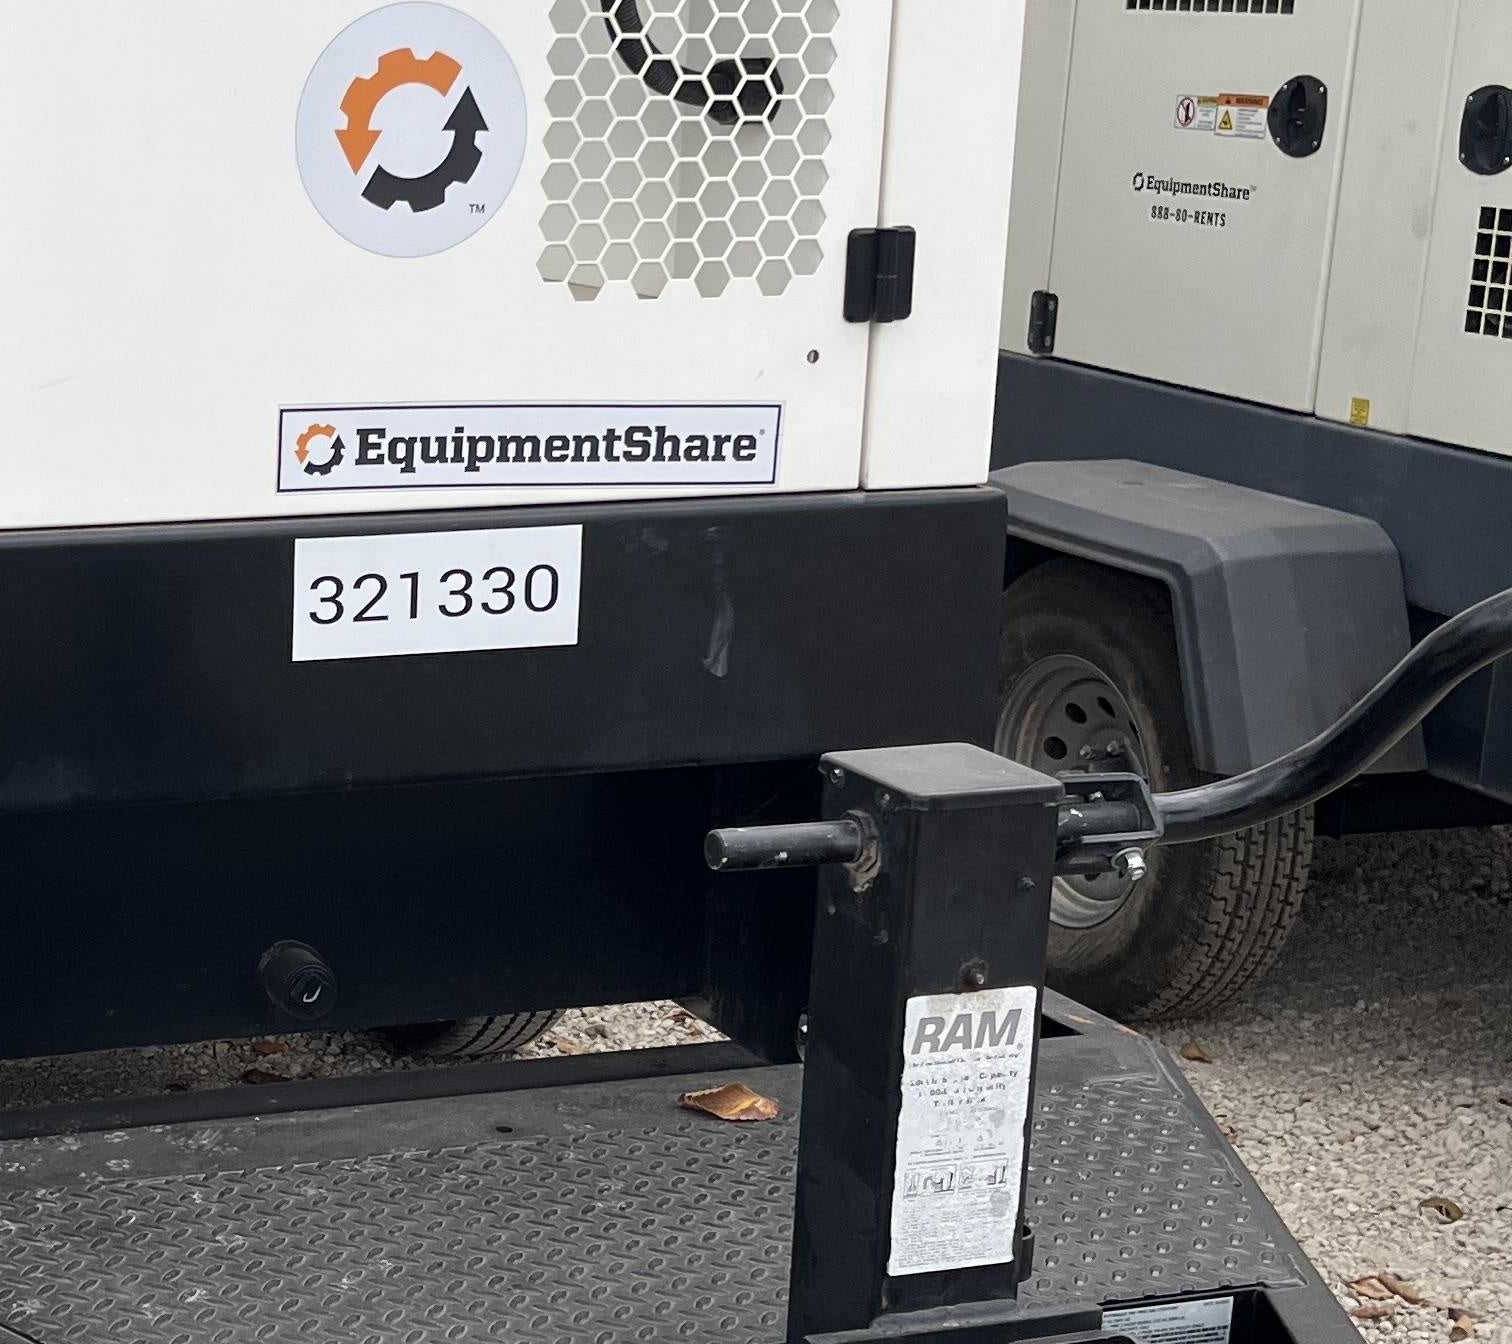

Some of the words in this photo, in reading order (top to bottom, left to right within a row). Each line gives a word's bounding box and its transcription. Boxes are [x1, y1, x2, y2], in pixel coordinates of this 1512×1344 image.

[1147, 175, 1251, 201] EquipmentShare
[1150, 205, 1227, 228] 888-80-RENTS
[355, 425, 758, 475] EquipmentShare
[307, 563, 560, 625] 321330
[910, 1008, 1023, 1056] RAM
